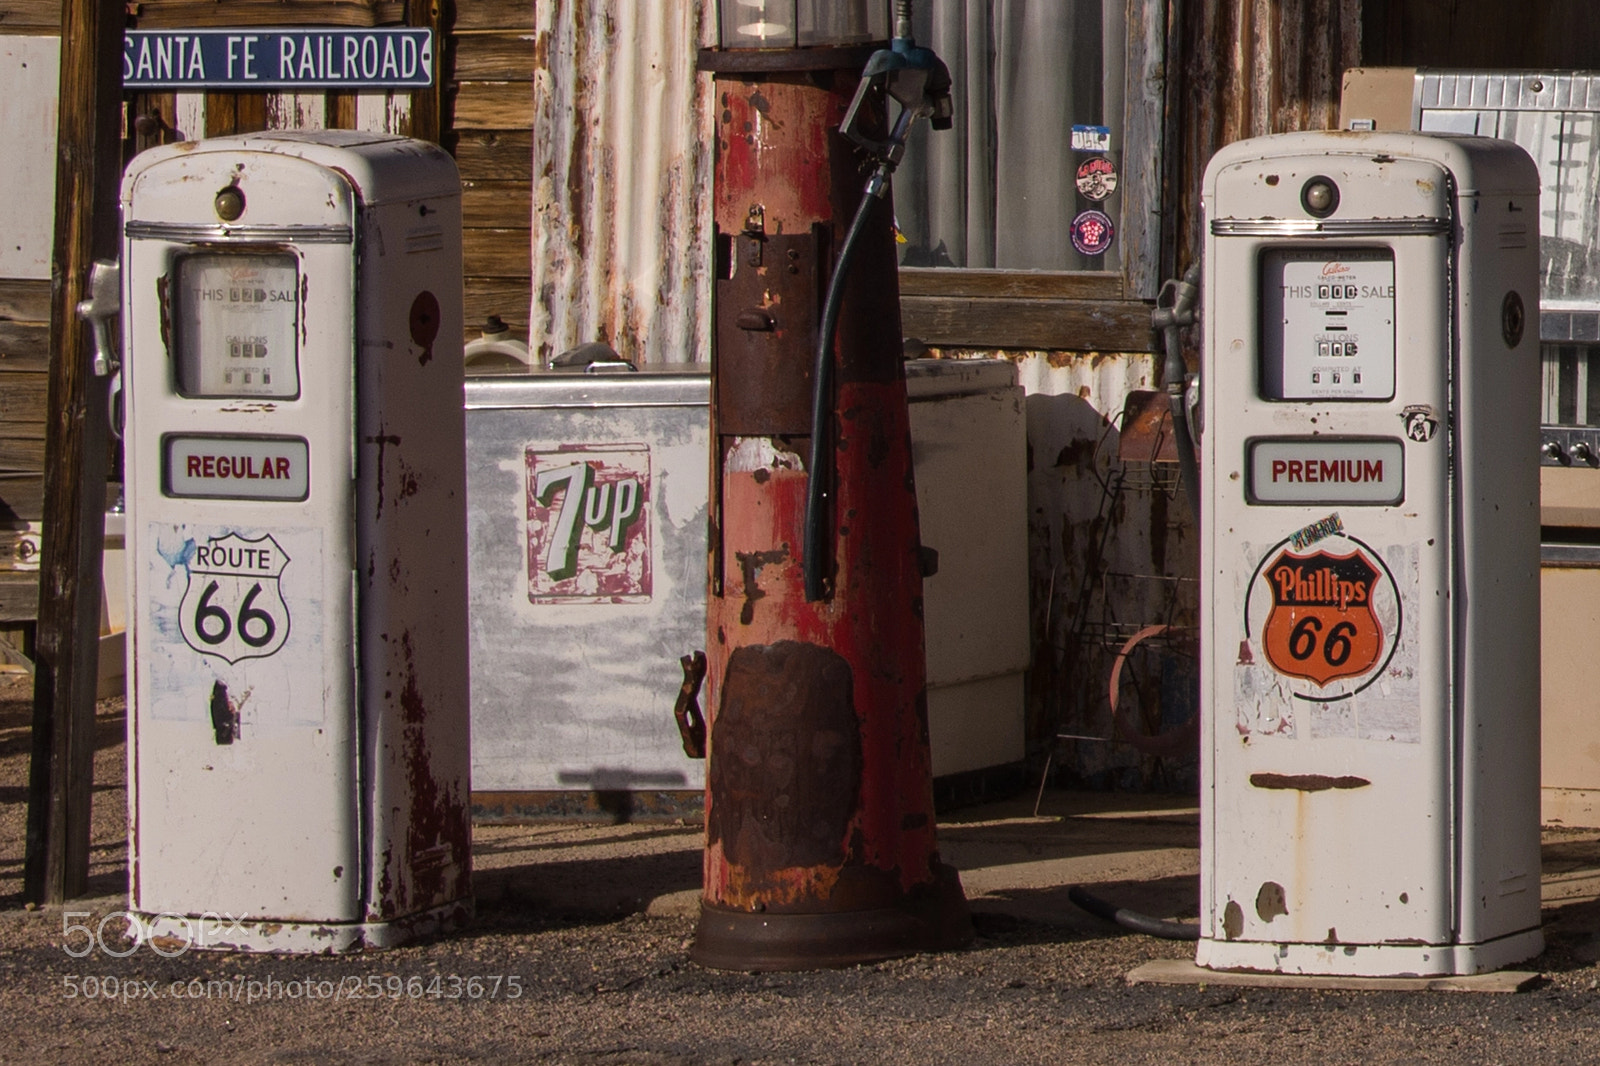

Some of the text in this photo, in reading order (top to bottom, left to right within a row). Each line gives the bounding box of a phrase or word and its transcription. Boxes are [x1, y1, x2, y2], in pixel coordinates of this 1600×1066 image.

[123, 35, 417, 79] SANTA FE RAILROAD
[193, 289, 224, 301] THIS
[1279, 285, 1312, 298] THIS
[1361, 285, 1394, 298] SALE
[225, 336, 268, 345] GALLONS
[1313, 334, 1359, 343] GALLONS
[187, 455, 291, 480] REGULAR
[1272, 460, 1383, 483] PREMIUM
[197, 546, 271, 570] ROUTE
[1274, 566, 1367, 612] Phillips
[195, 580, 277, 648] 66
[1288, 616, 1358, 667] 66
